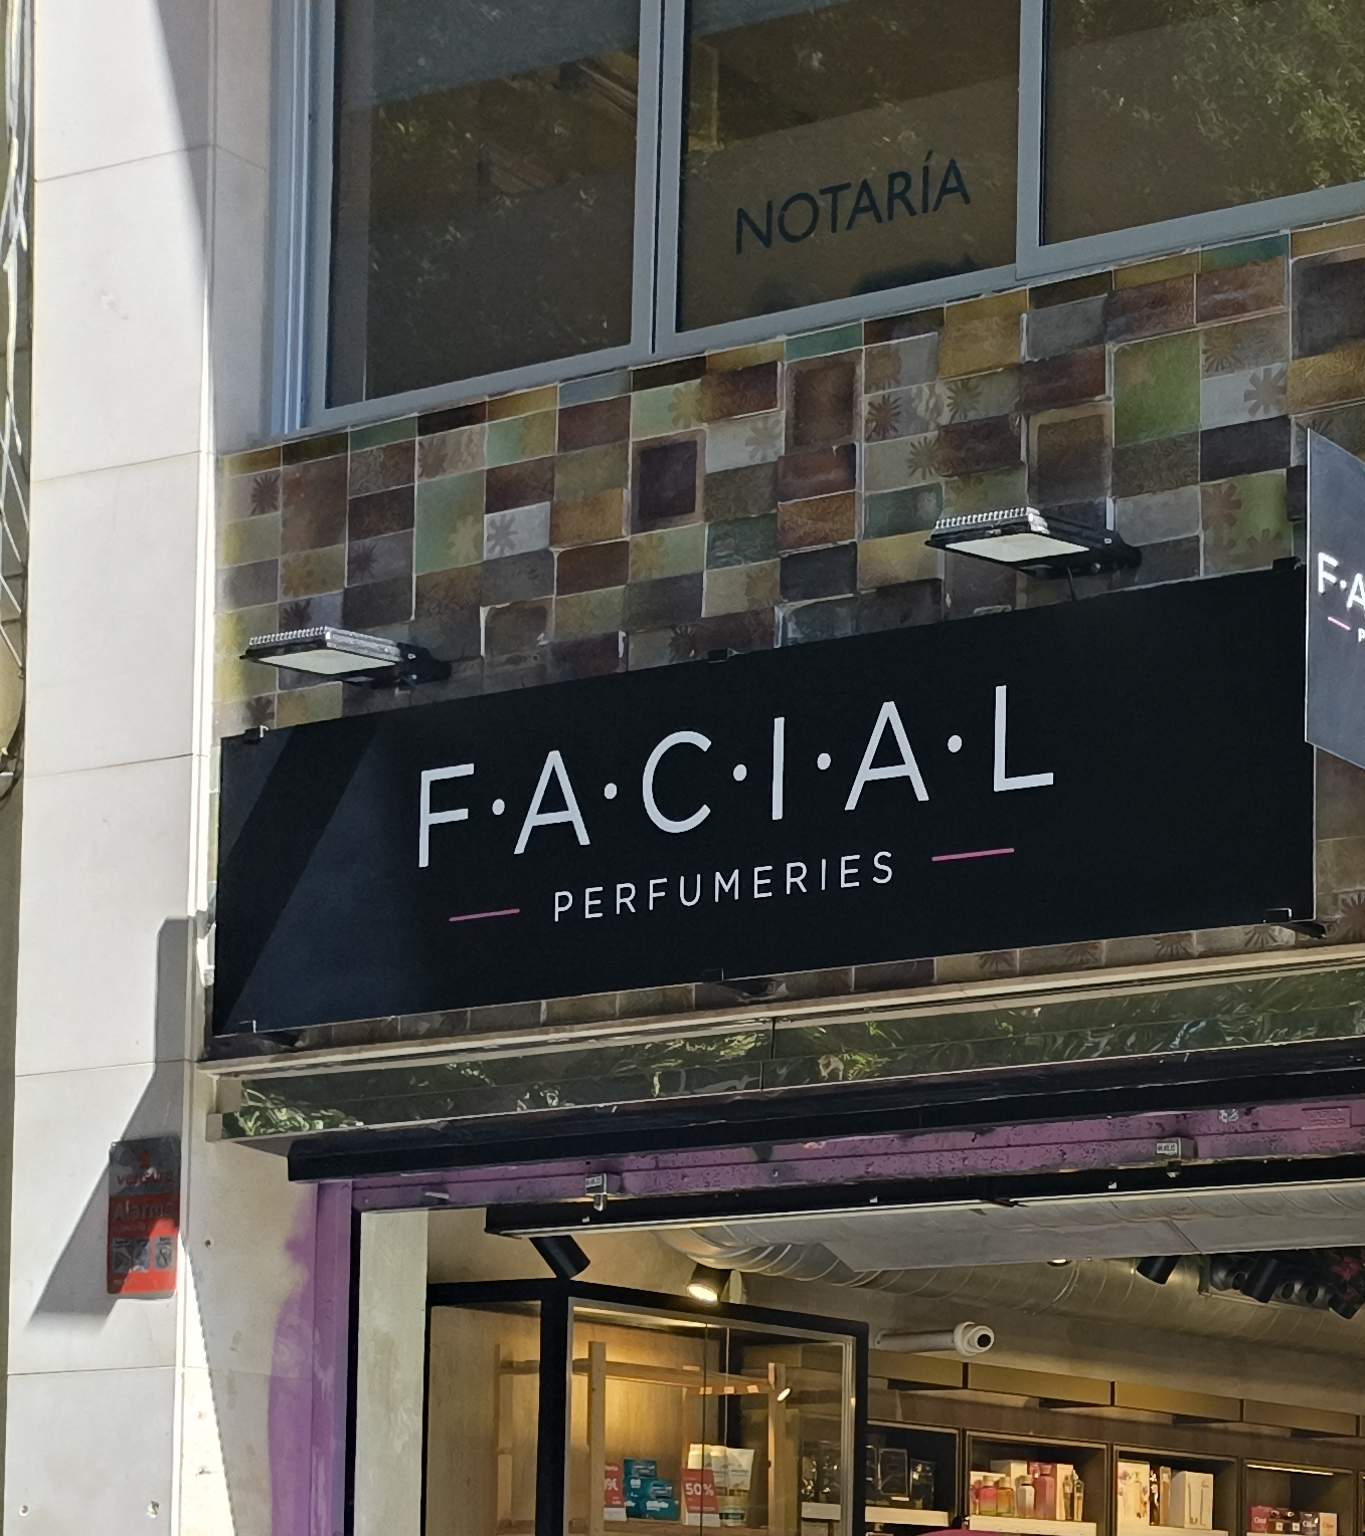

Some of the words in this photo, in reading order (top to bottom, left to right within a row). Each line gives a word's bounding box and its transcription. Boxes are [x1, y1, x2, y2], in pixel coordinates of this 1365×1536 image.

[736, 150, 970, 255] NOTARÍA
[553, 851, 893, 922] PERFUMERIES
[685, 1483, 715, 1496] 50%
